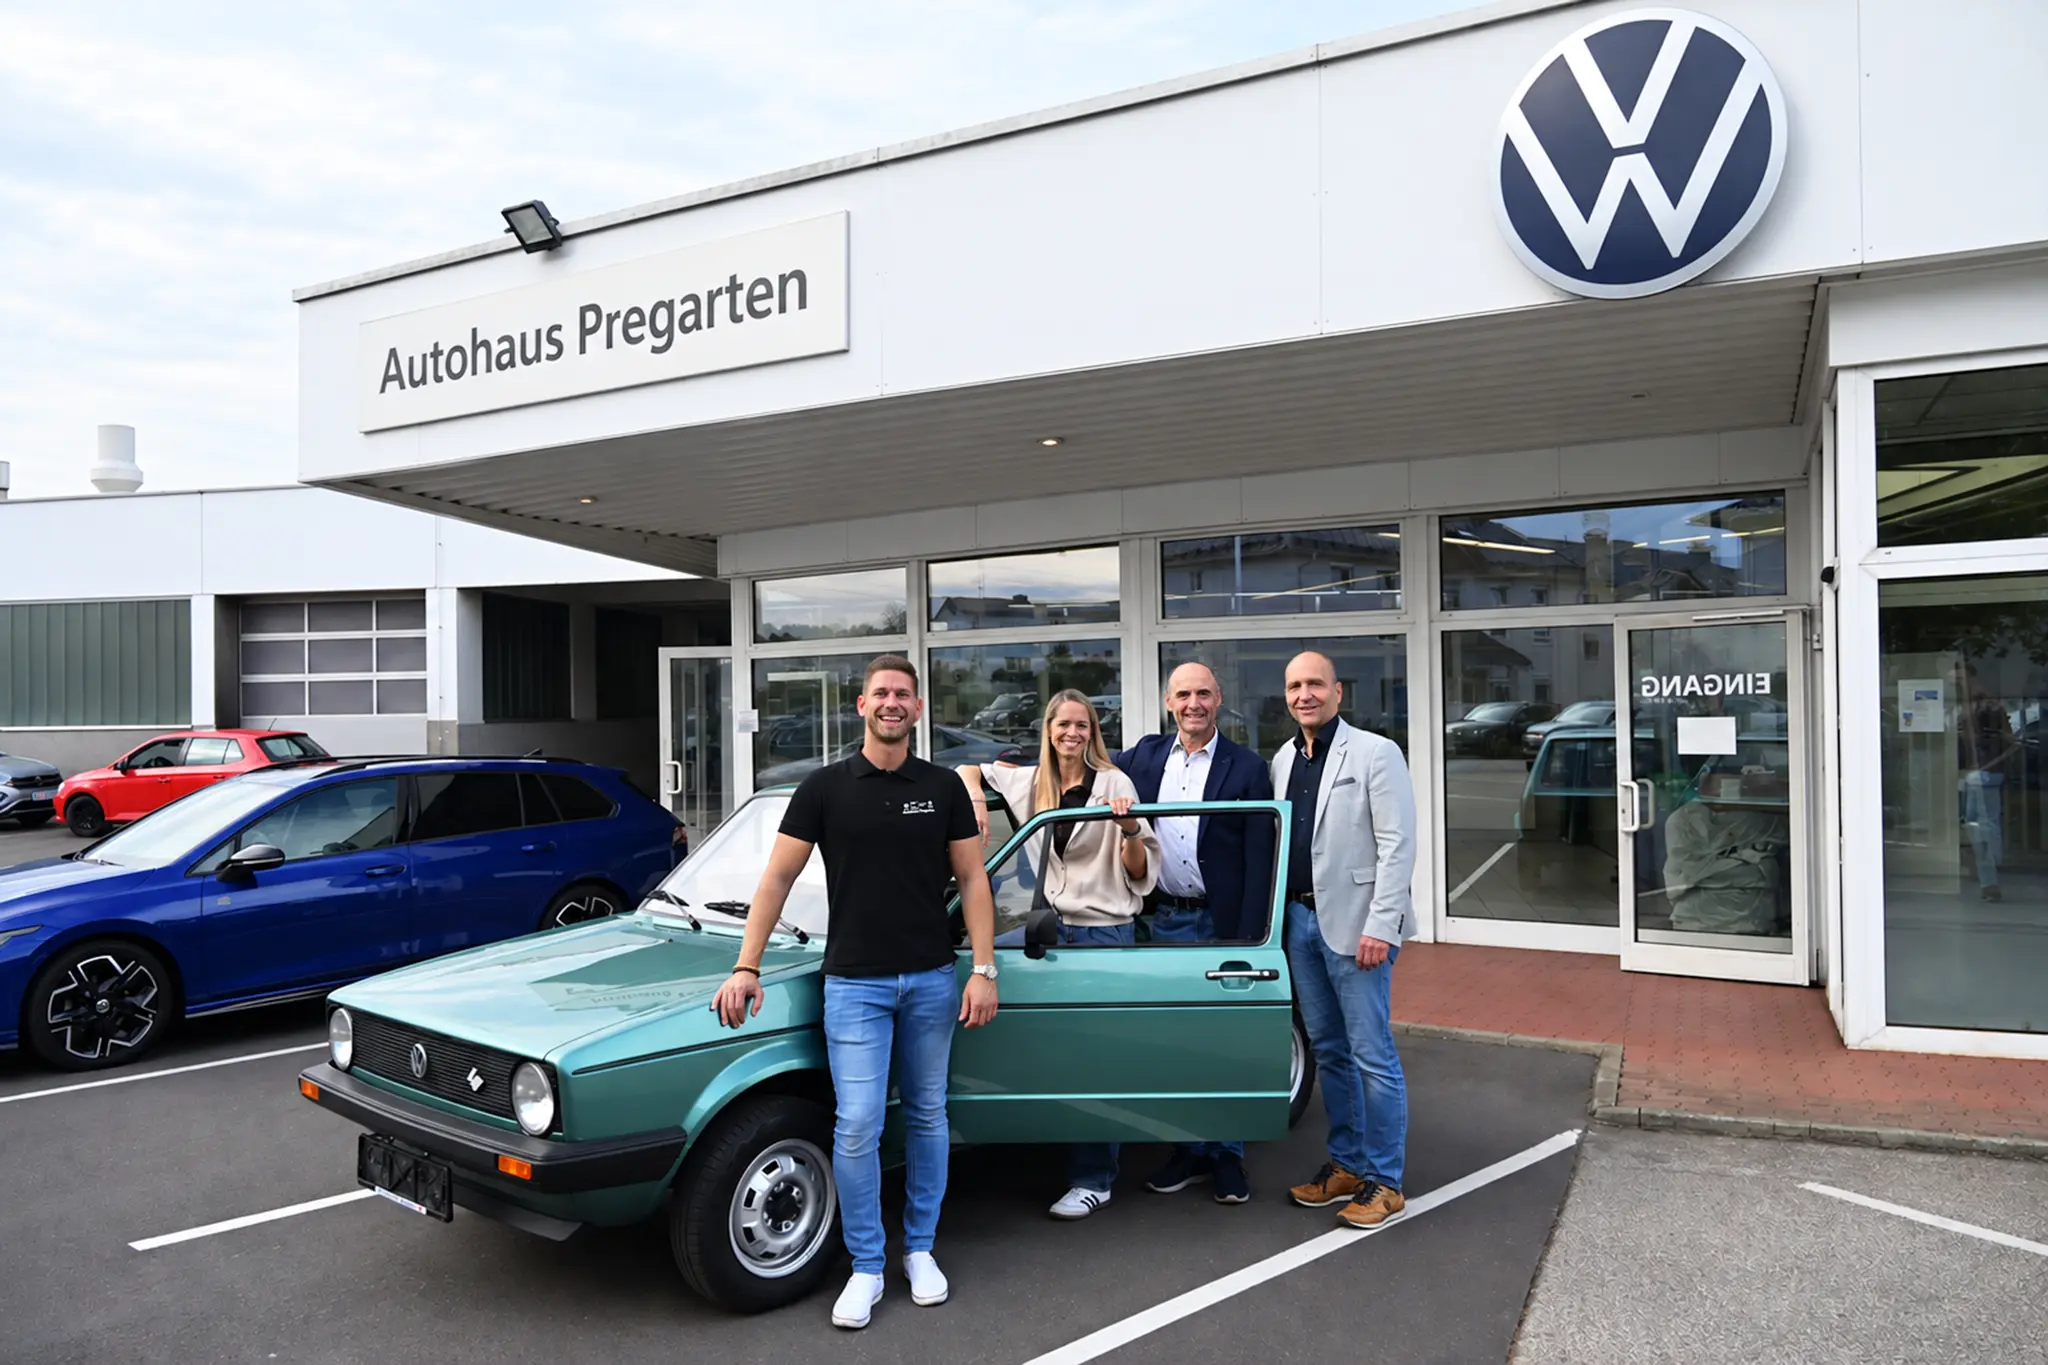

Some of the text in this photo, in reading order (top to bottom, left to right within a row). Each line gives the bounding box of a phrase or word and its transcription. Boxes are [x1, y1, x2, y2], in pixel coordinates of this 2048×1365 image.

[1497, 9, 1784, 284] VW
[379, 268, 809, 395] Autohaus Pregarten
